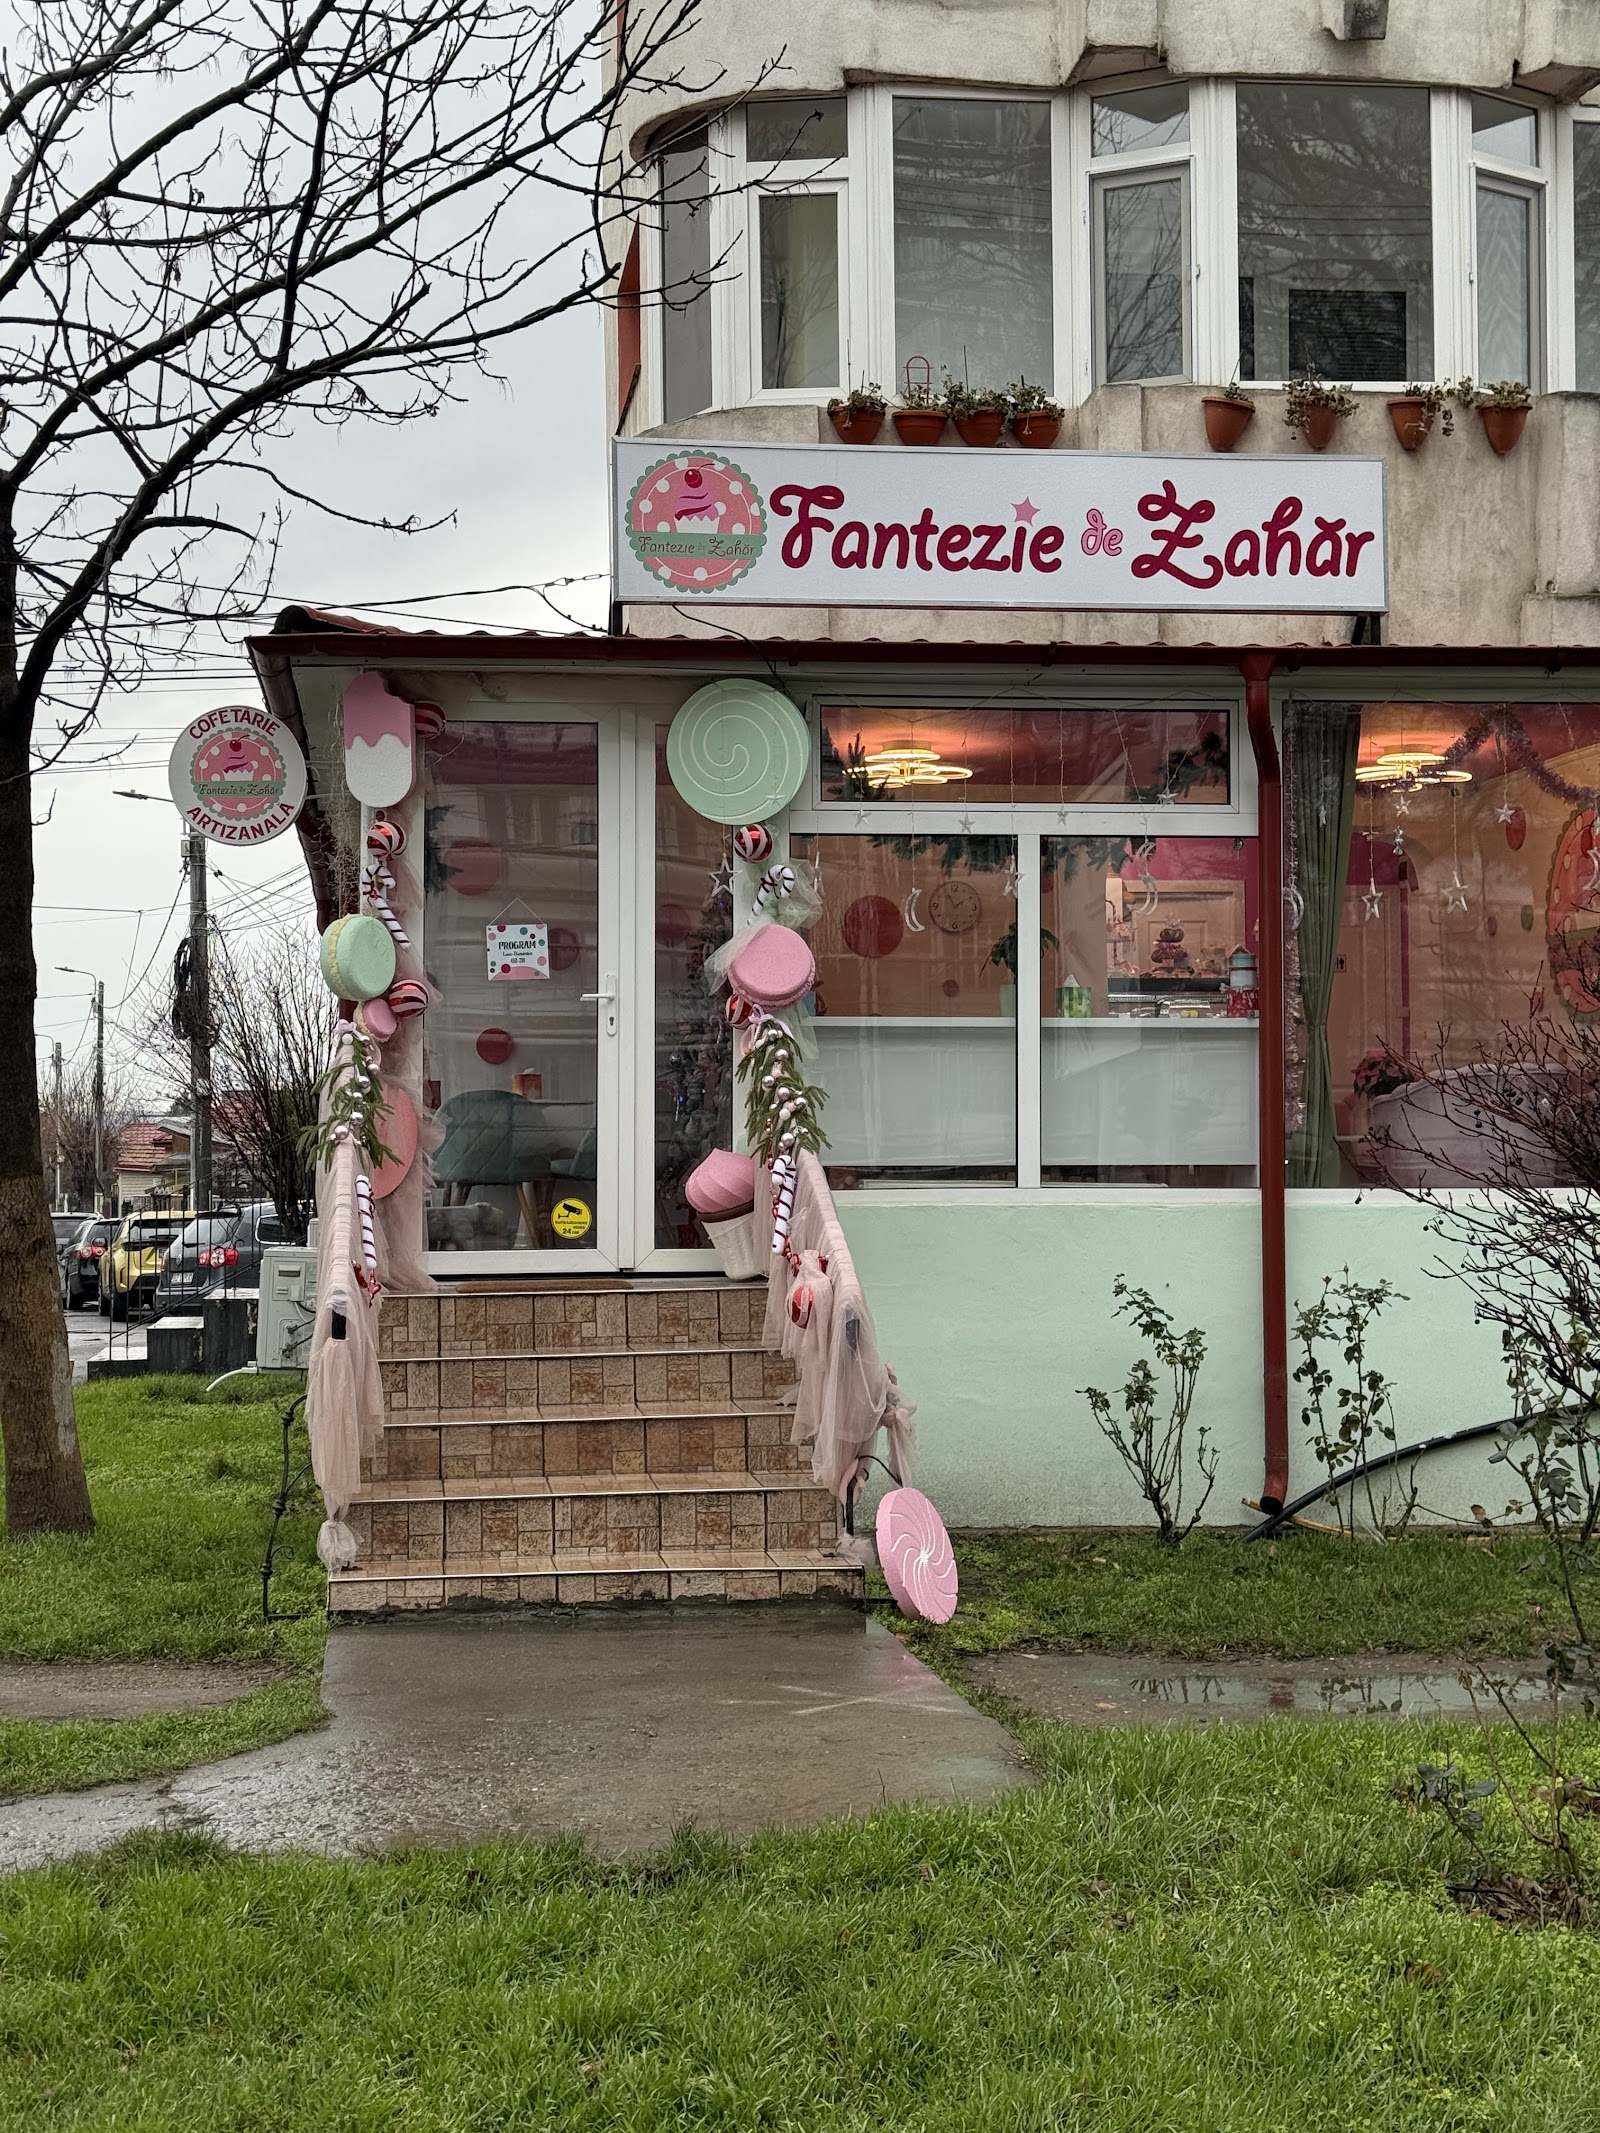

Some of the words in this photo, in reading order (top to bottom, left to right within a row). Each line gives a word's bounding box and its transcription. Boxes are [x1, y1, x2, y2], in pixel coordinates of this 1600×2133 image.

[770, 484, 1062, 573] Fantezie
[1080, 508, 1122, 558] de
[1130, 479, 1375, 590] Zahăr
[638, 536, 695, 553] Fantezie
[707, 536, 756, 557] Zahăr
[498, 940, 537, 950] PROGRAM
